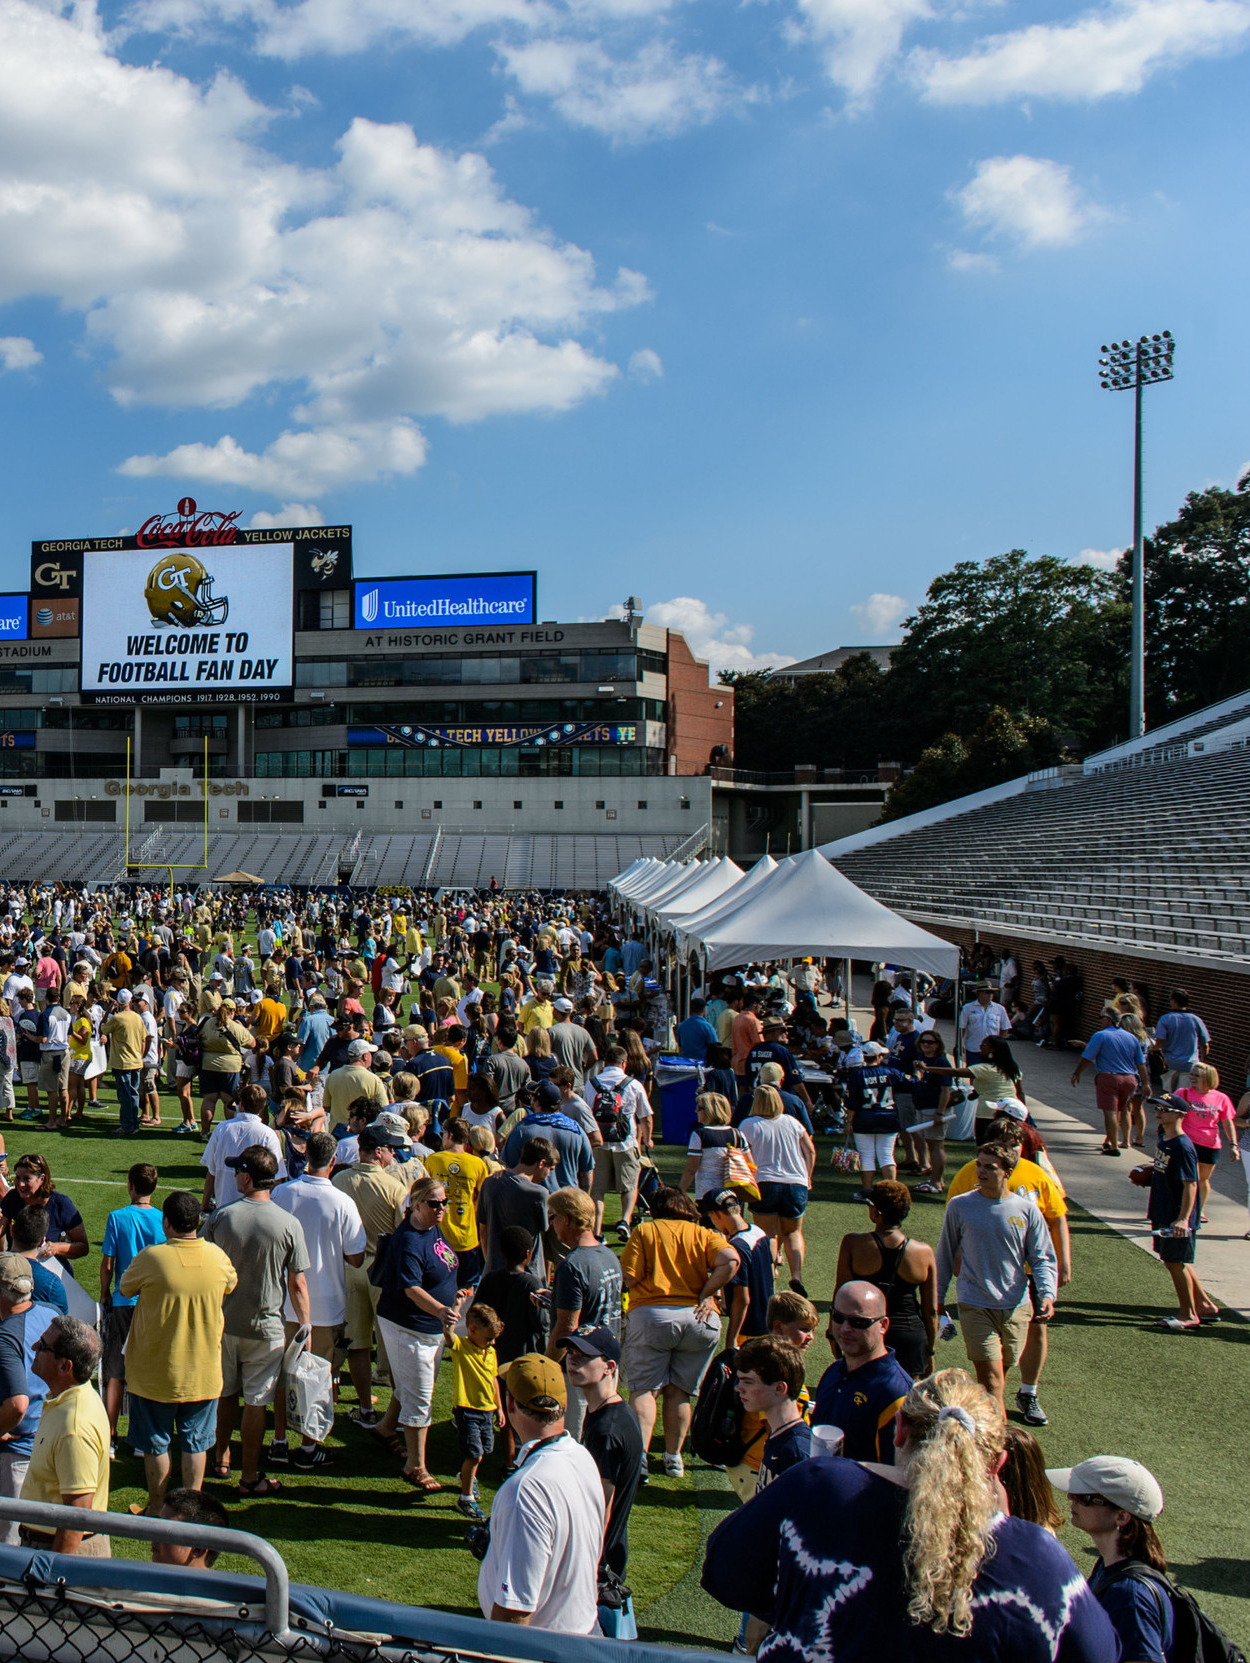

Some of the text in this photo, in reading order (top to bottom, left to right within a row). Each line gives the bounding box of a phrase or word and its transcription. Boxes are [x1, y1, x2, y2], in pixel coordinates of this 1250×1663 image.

[137, 510, 243, 548] Coca-Cola
[244, 527, 350, 542] YELLOW JACKETS
[41, 538, 123, 552] GEORGIA TECH
[34, 562, 77, 590] GT
[157, 564, 191, 591] GT
[56, 611, 76, 621] at&t
[126, 632, 249, 656] WELCOME TO
[365, 630, 565, 647] AT HISTORIC GRANT FIELD
[97, 658, 279, 683] FOOTBALL FAN DAY
[95, 695, 136, 704] NATIONAL
[141, 694, 193, 703] CHAMPIONS
[260, 692, 281, 702] 1990
[446, 729, 482, 742] TECH
[104, 780, 249, 800] Georgia Tech
